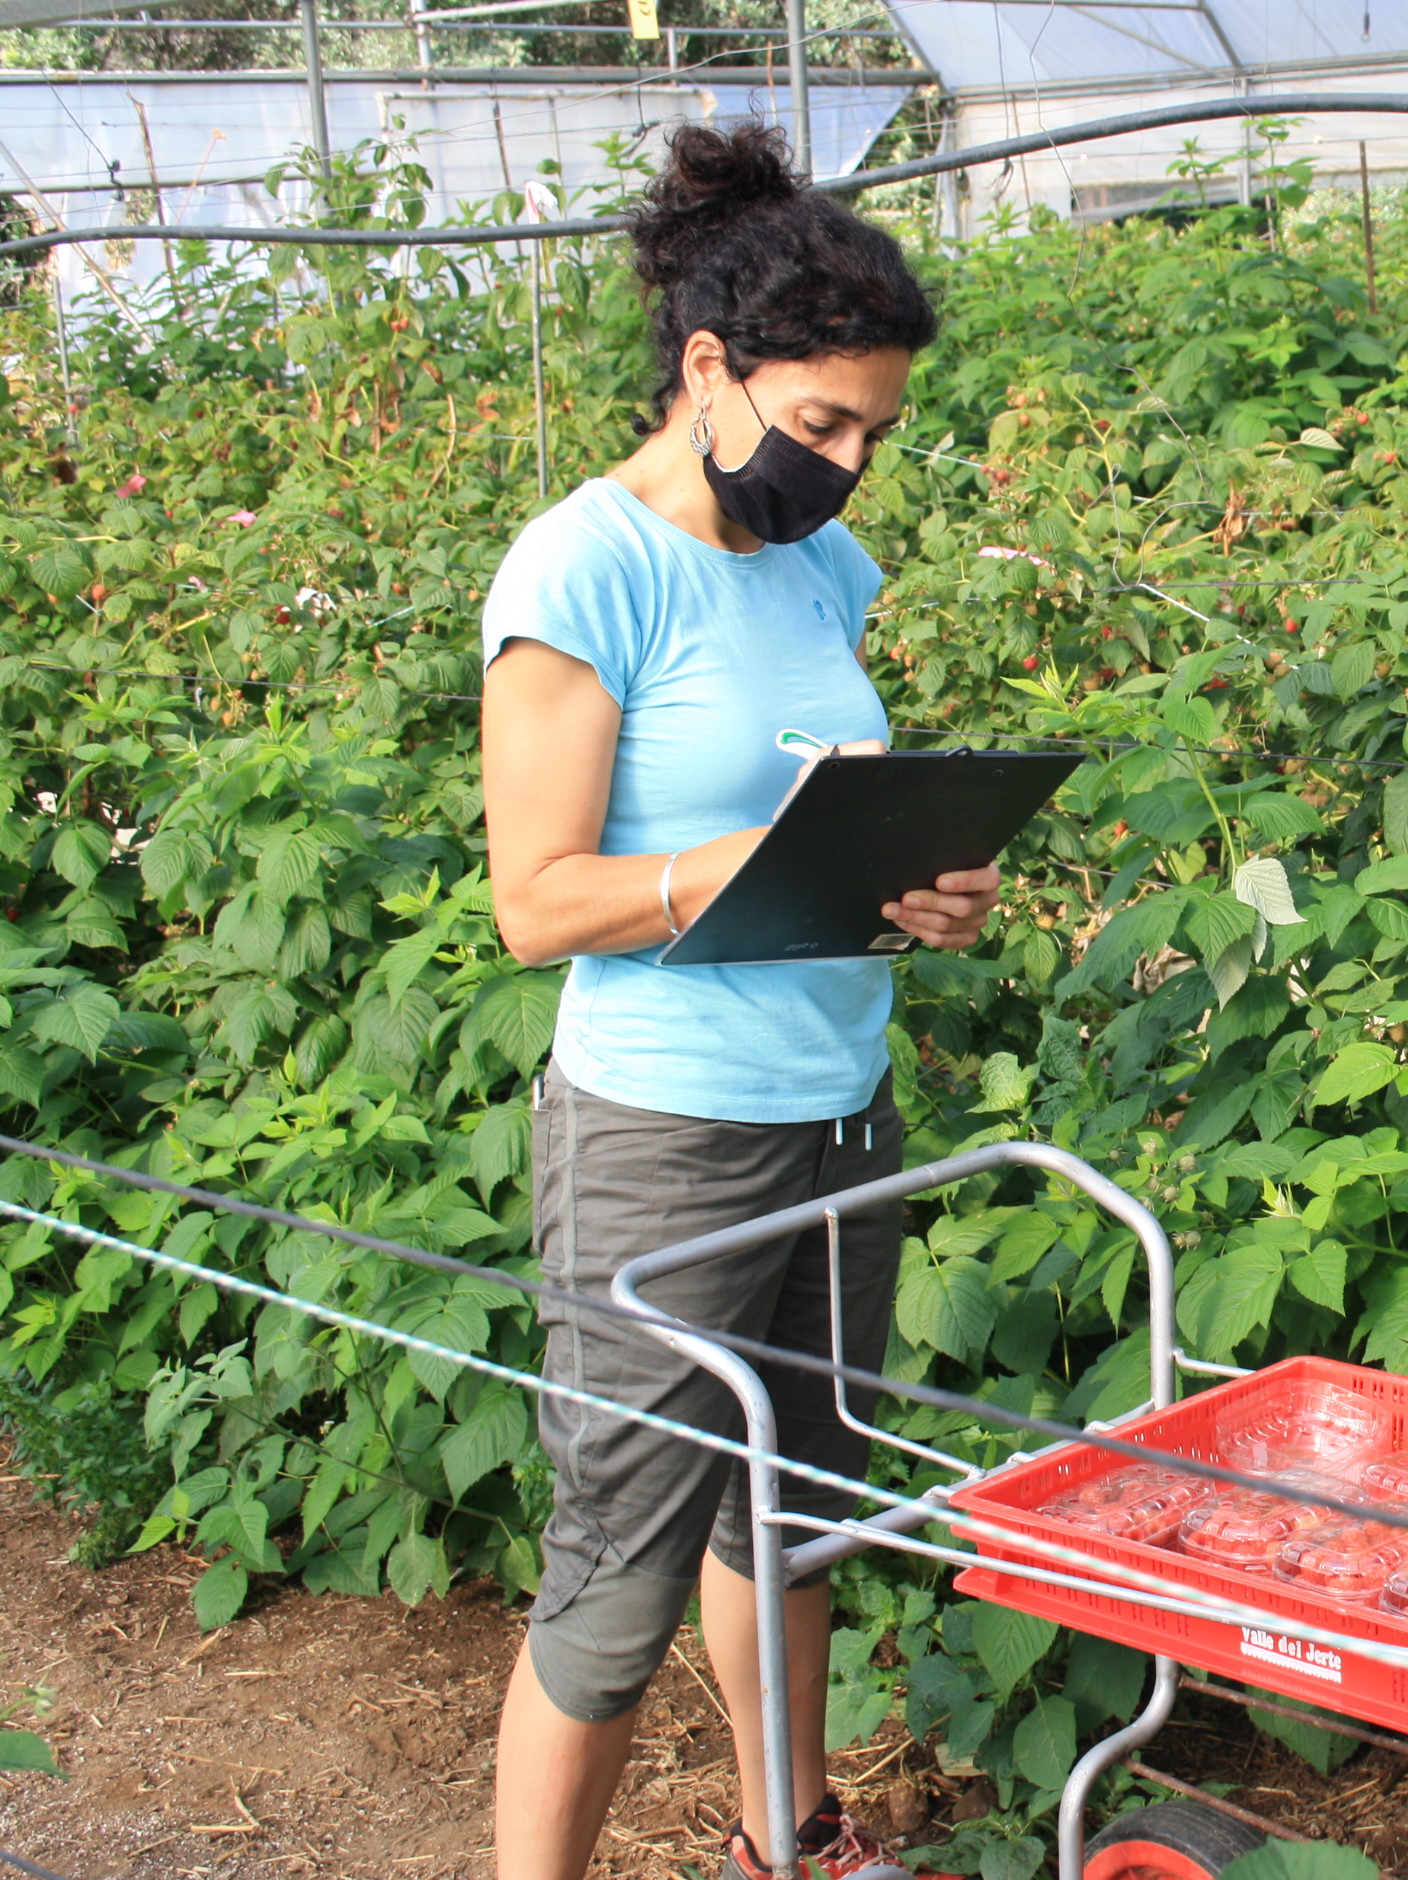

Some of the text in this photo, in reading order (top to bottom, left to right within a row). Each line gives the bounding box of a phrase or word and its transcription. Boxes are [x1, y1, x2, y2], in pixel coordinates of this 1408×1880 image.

[1242, 1627, 1274, 1650] Valle
[1278, 1636, 1302, 1659] del
[1306, 1643, 1342, 1670] Jerte
